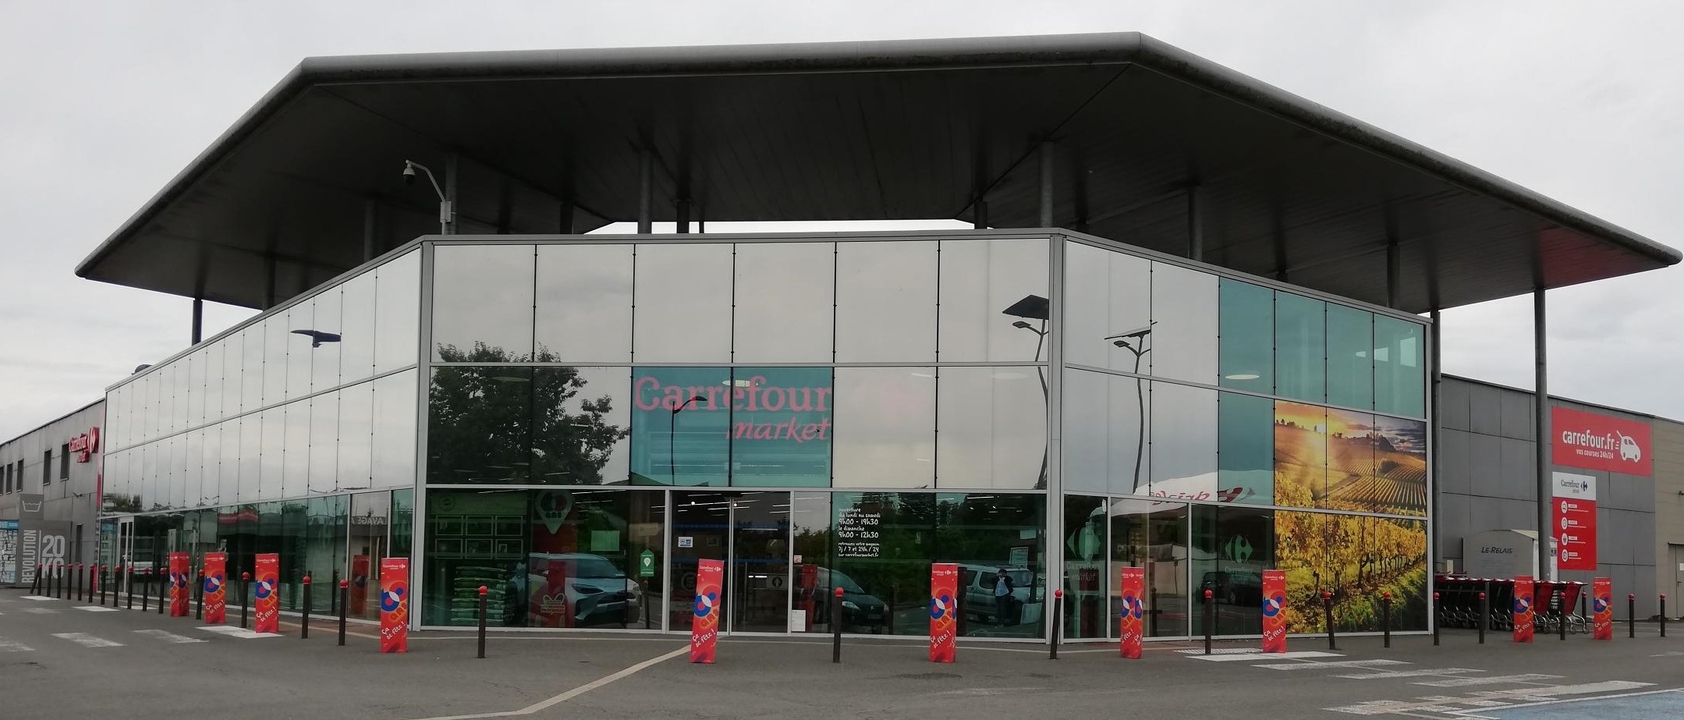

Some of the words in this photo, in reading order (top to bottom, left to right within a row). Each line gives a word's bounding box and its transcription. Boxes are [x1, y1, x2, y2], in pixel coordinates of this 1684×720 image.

[634, 375, 832, 412] Carrefour
[726, 416, 832, 443] market
[1562, 429, 1615, 451] carrefour.fr
[41, 534, 66, 558] 20
[860, 531, 879, 539] 12h30
[21, 529, 37, 583] REVOLUTION
